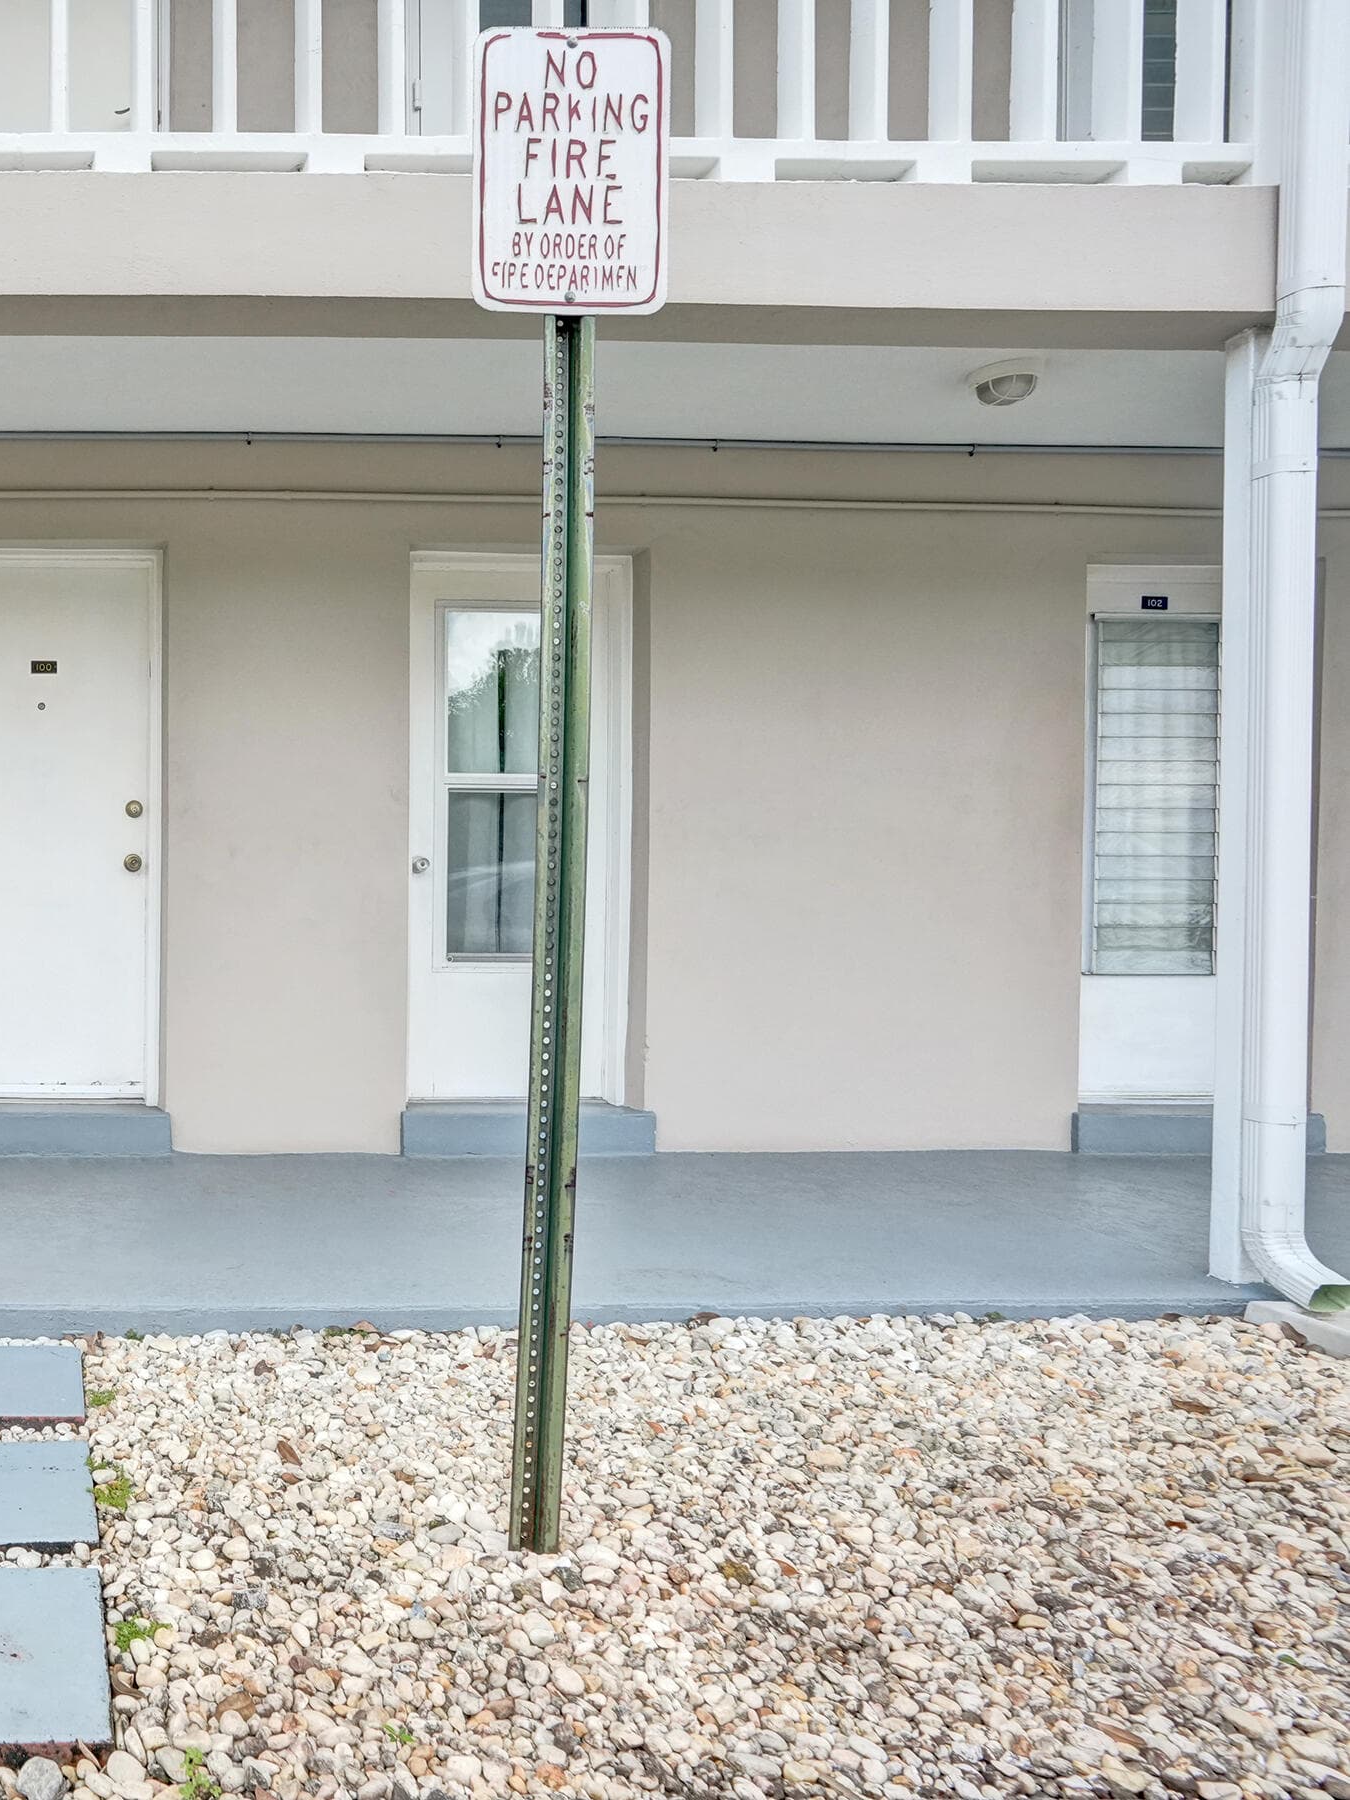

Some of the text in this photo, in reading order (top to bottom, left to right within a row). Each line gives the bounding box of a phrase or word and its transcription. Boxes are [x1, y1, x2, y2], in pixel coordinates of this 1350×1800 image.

[545, 49, 597, 89] NO
[494, 91, 649, 133] PARKING
[525, 137, 617, 180] FIRE
[517, 183, 623, 225] LANE
[512, 231, 627, 260] BY ORDER OF
[1147, 599, 1163, 607] 102
[36, 663, 52, 671] 100
